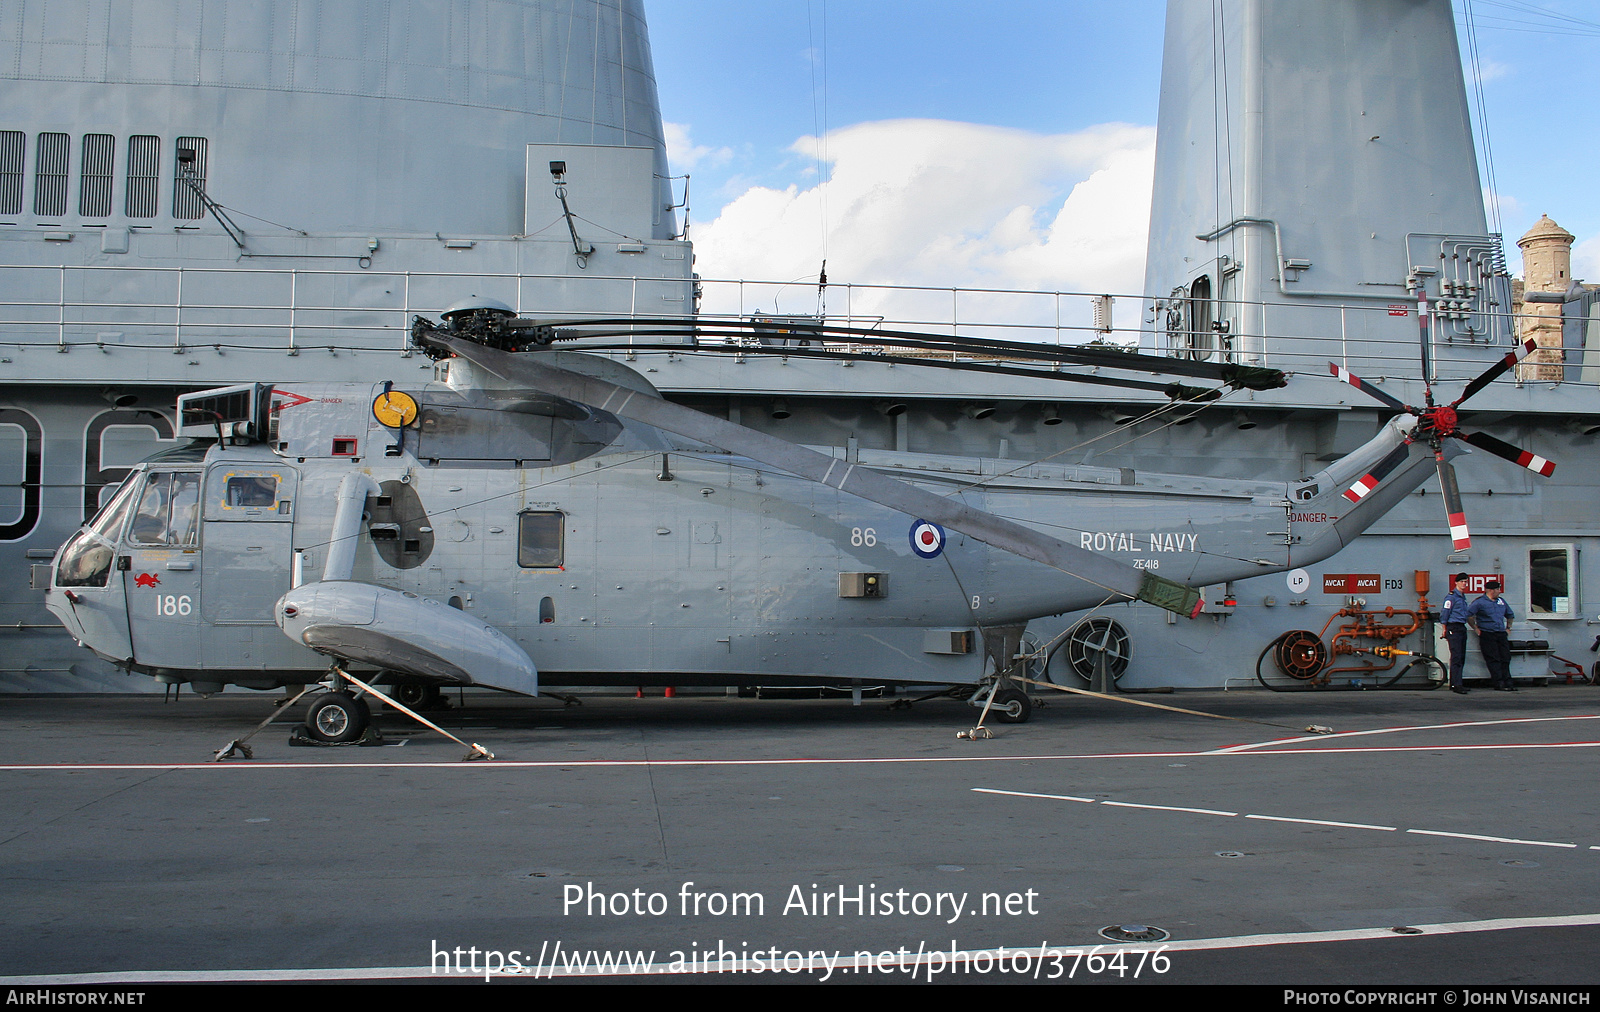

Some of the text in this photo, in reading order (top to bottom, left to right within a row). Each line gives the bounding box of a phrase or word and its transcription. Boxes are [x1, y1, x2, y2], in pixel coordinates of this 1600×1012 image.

[1290, 512, 1327, 523] DANGER
[850, 527, 877, 547] 86
[1080, 532, 1198, 553] ROYAL NAVY
[1132, 558, 1159, 570] ZE418
[1293, 577, 1304, 585] LP
[1324, 579, 1378, 587] AVCAT AVCAT
[1384, 579, 1403, 590] FD3
[1463, 576, 1498, 592] IR
[157, 594, 192, 616] 186
[971, 595, 981, 610] B
